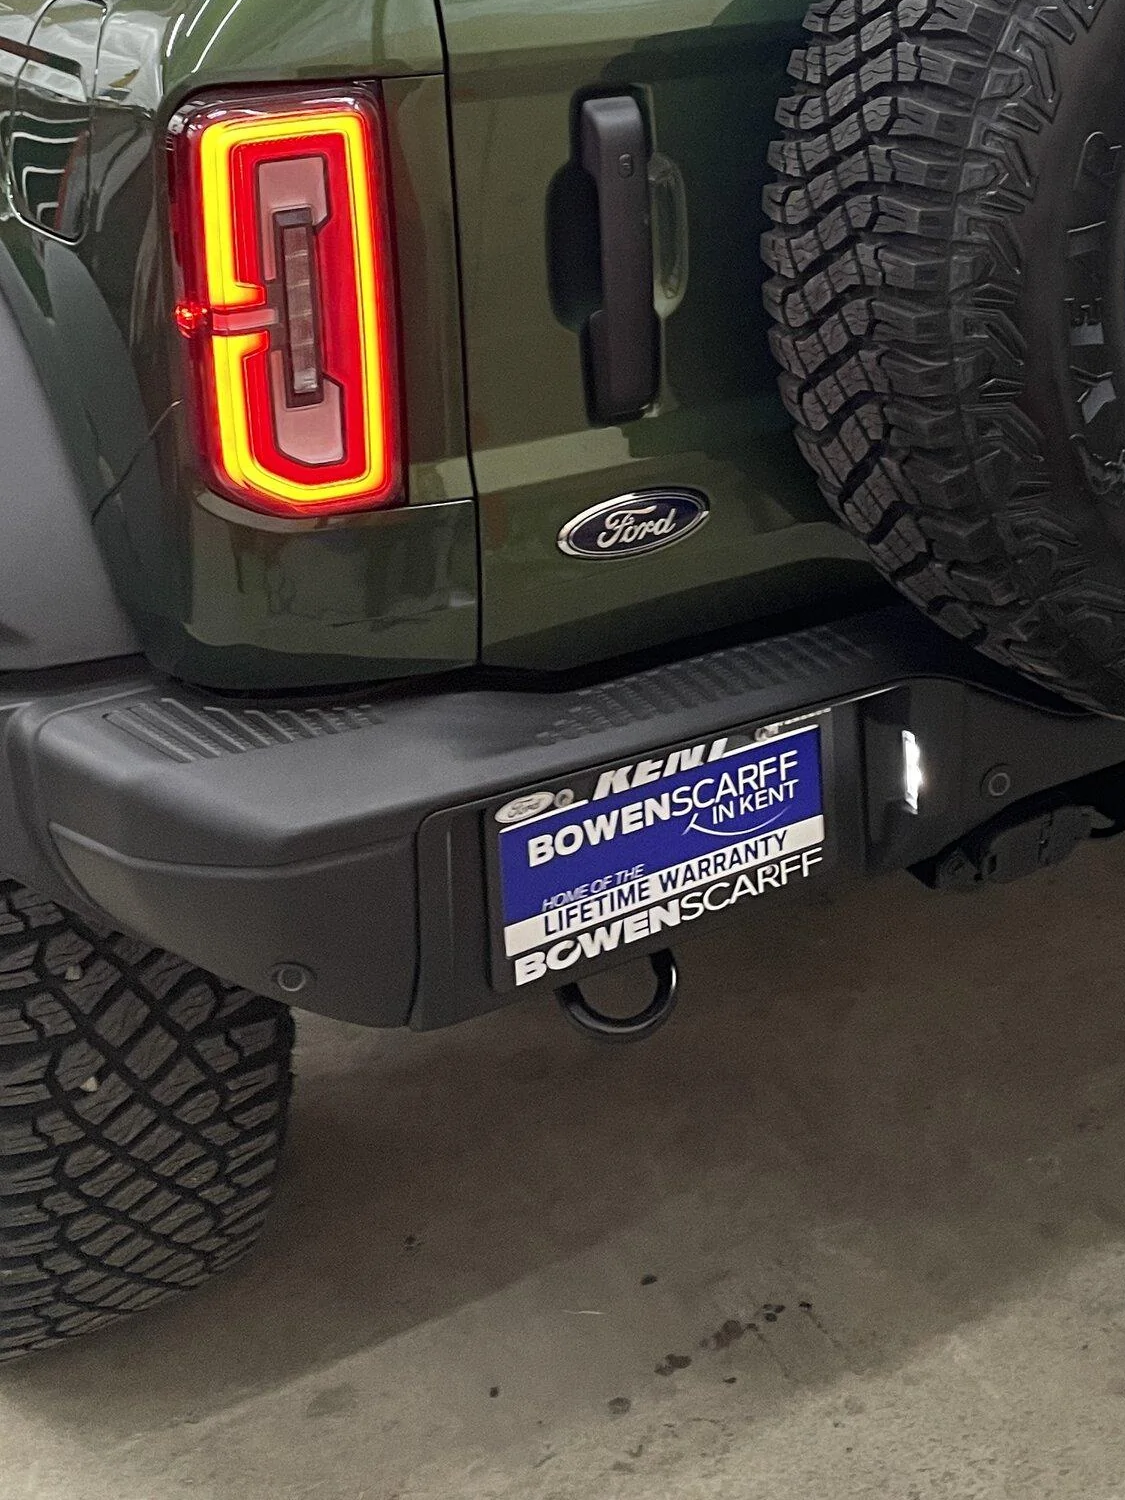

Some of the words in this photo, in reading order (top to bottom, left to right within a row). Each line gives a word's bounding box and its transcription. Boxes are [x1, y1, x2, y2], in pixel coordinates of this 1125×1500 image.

[596, 504, 677, 549] Ford
[527, 749, 799, 868] BOWENSCARFF
[711, 799, 736, 826] IN
[739, 778, 800, 816] KENT
[514, 846, 824, 987] BOWENSCARFF
[541, 883, 591, 912] HOME
[589, 874, 614, 895] OF
[615, 863, 646, 887] THE
[544, 878, 651, 938] LIFETIME
[658, 829, 790, 895] WARRANTY
